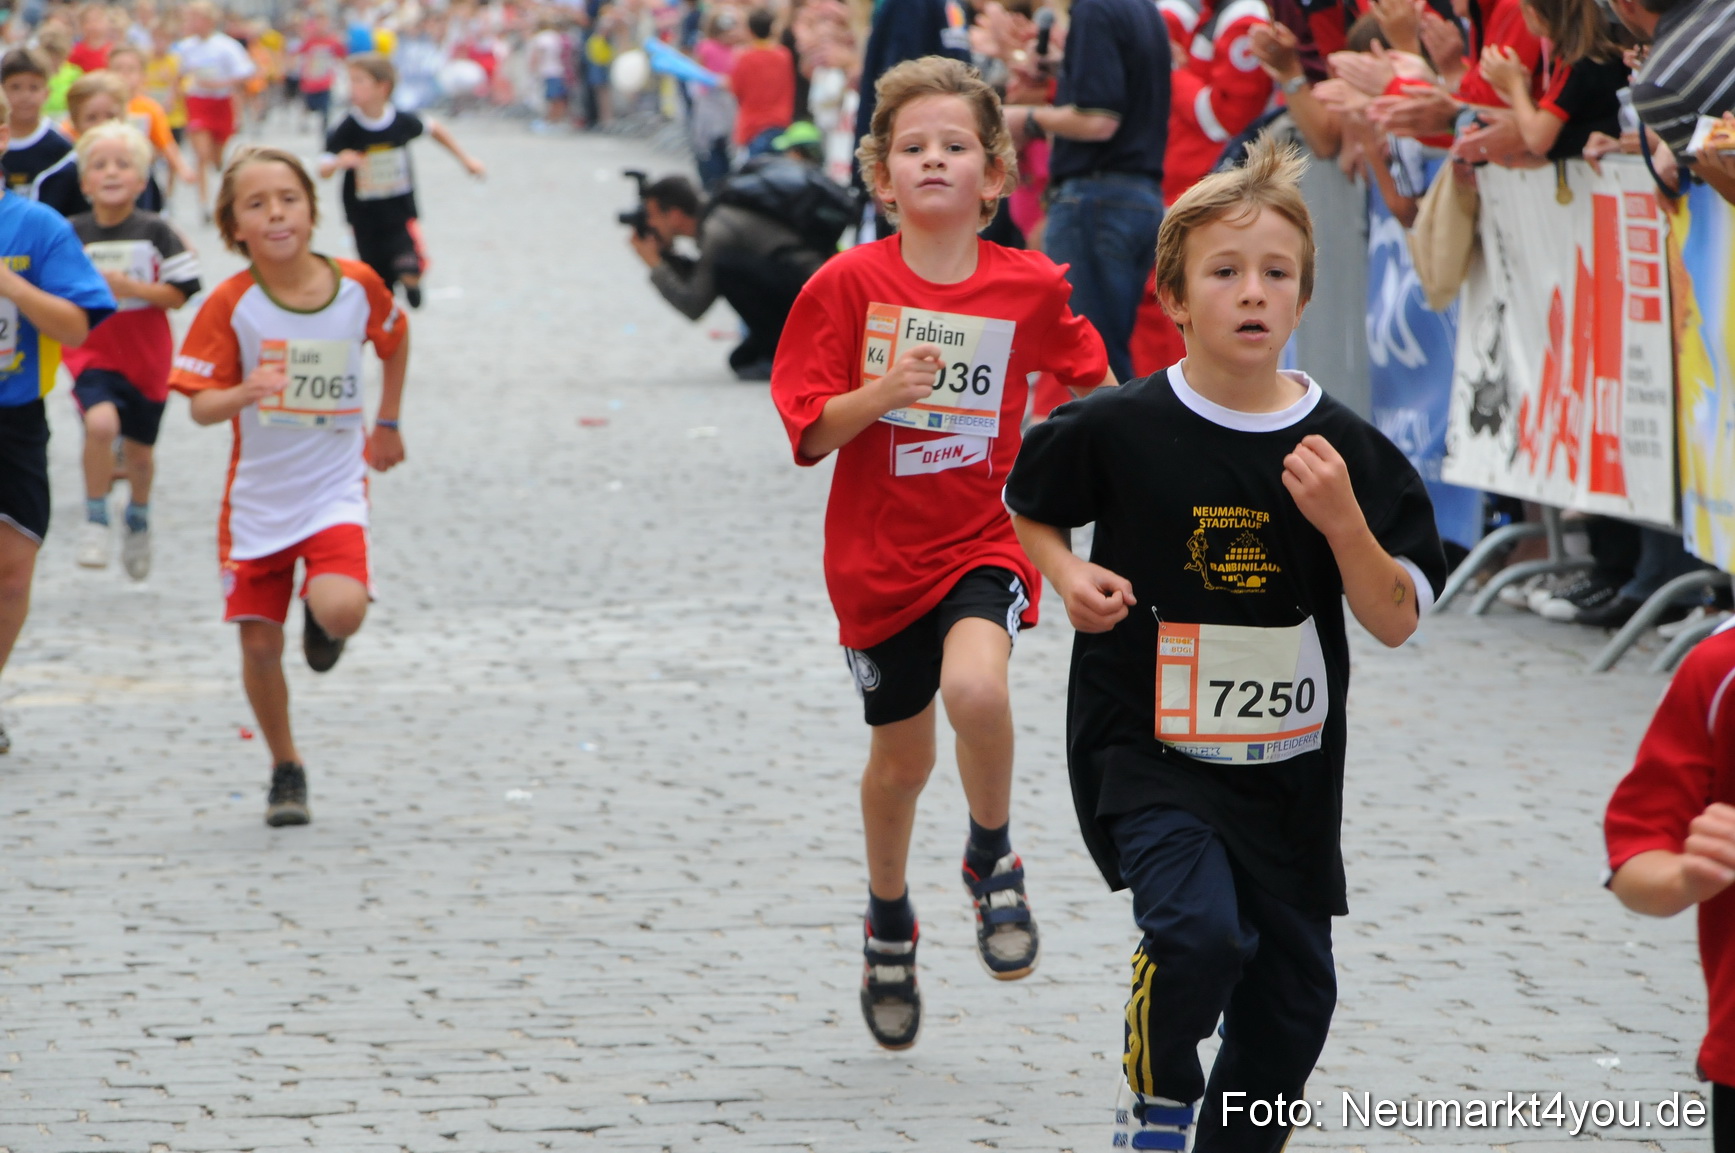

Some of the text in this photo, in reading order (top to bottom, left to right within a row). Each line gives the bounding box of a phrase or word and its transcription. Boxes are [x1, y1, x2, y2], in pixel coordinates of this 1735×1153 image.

[906, 317, 965, 346] Fabian
[292, 348, 320, 364] Luis
[867, 347, 884, 364] K4
[294, 375, 358, 399] 7063
[932, 362, 992, 396] 036
[944, 414, 996, 428] PFLEIDERER
[922, 444, 964, 464] DEHN
[1193, 506, 1270, 523] NEUMARKTER
[1200, 518, 1262, 530] STADTLAUF
[1209, 677, 1315, 718] 7250
[1266, 731, 1320, 753] PFLEIDERER
